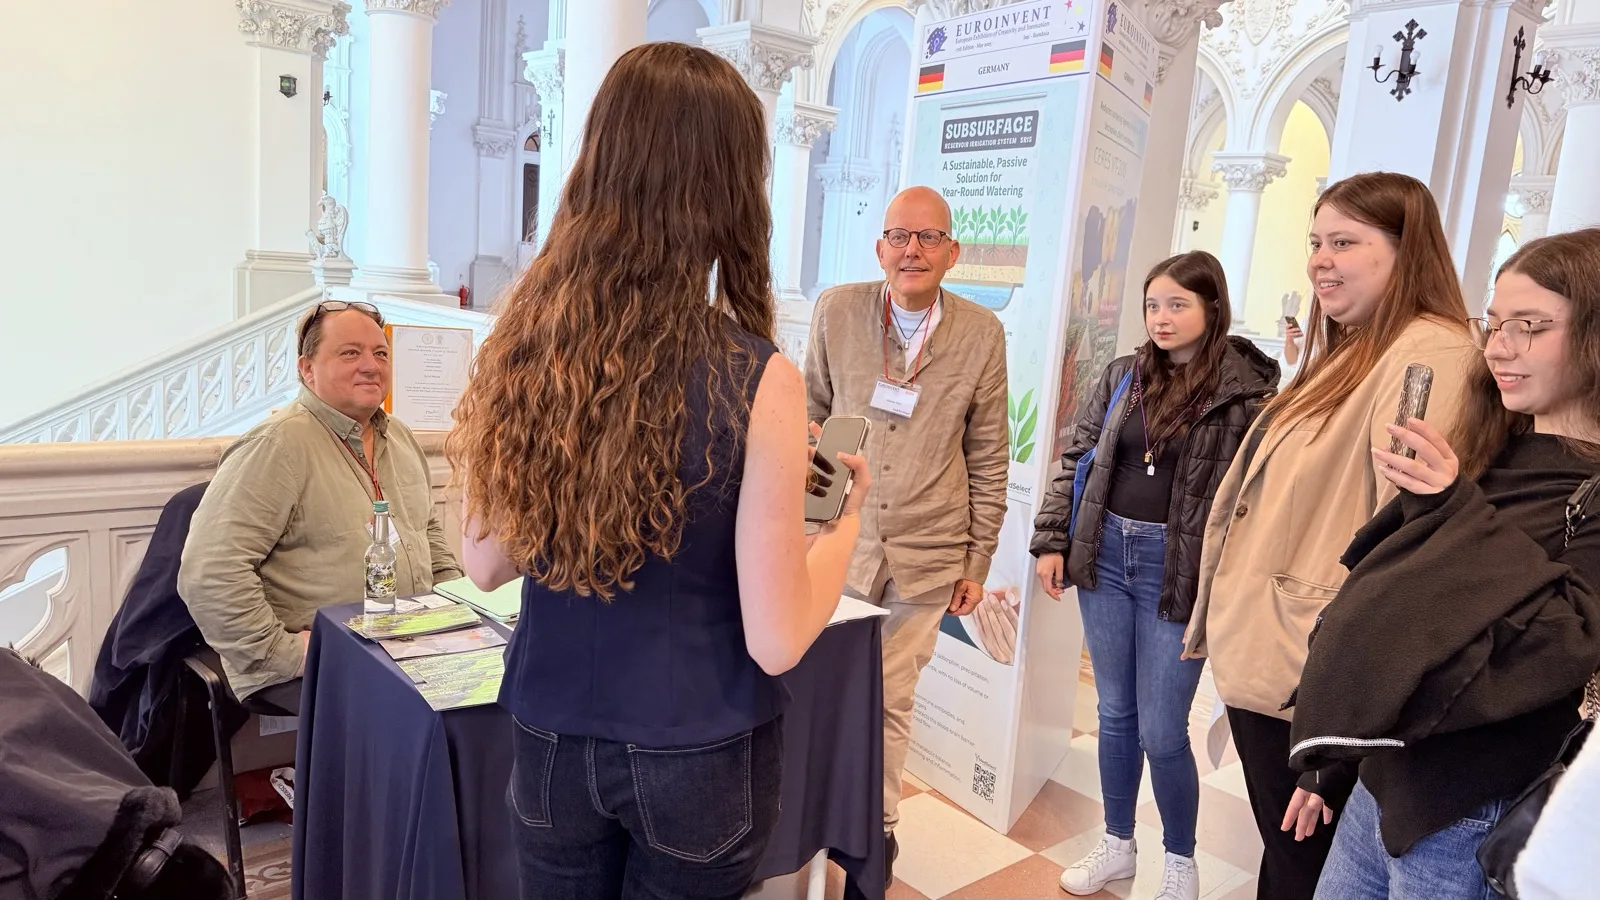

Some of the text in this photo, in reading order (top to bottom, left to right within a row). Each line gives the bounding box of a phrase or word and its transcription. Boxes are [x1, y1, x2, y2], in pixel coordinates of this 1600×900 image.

[956, 6, 1051, 37] EUROINVENT
[978, 62, 1010, 76] GERMANY
[945, 116, 1034, 140] SUBSURFACE
[944, 141, 969, 150] RESERVOIR
[969, 139, 997, 148] IRRIGATION
[997, 137, 1017, 145] SYSTEM
[942, 156, 1028, 171] A Sustainable, Passive
[956, 172, 1002, 184] Solution for
[942, 185, 1023, 198] Year-Round Watering
